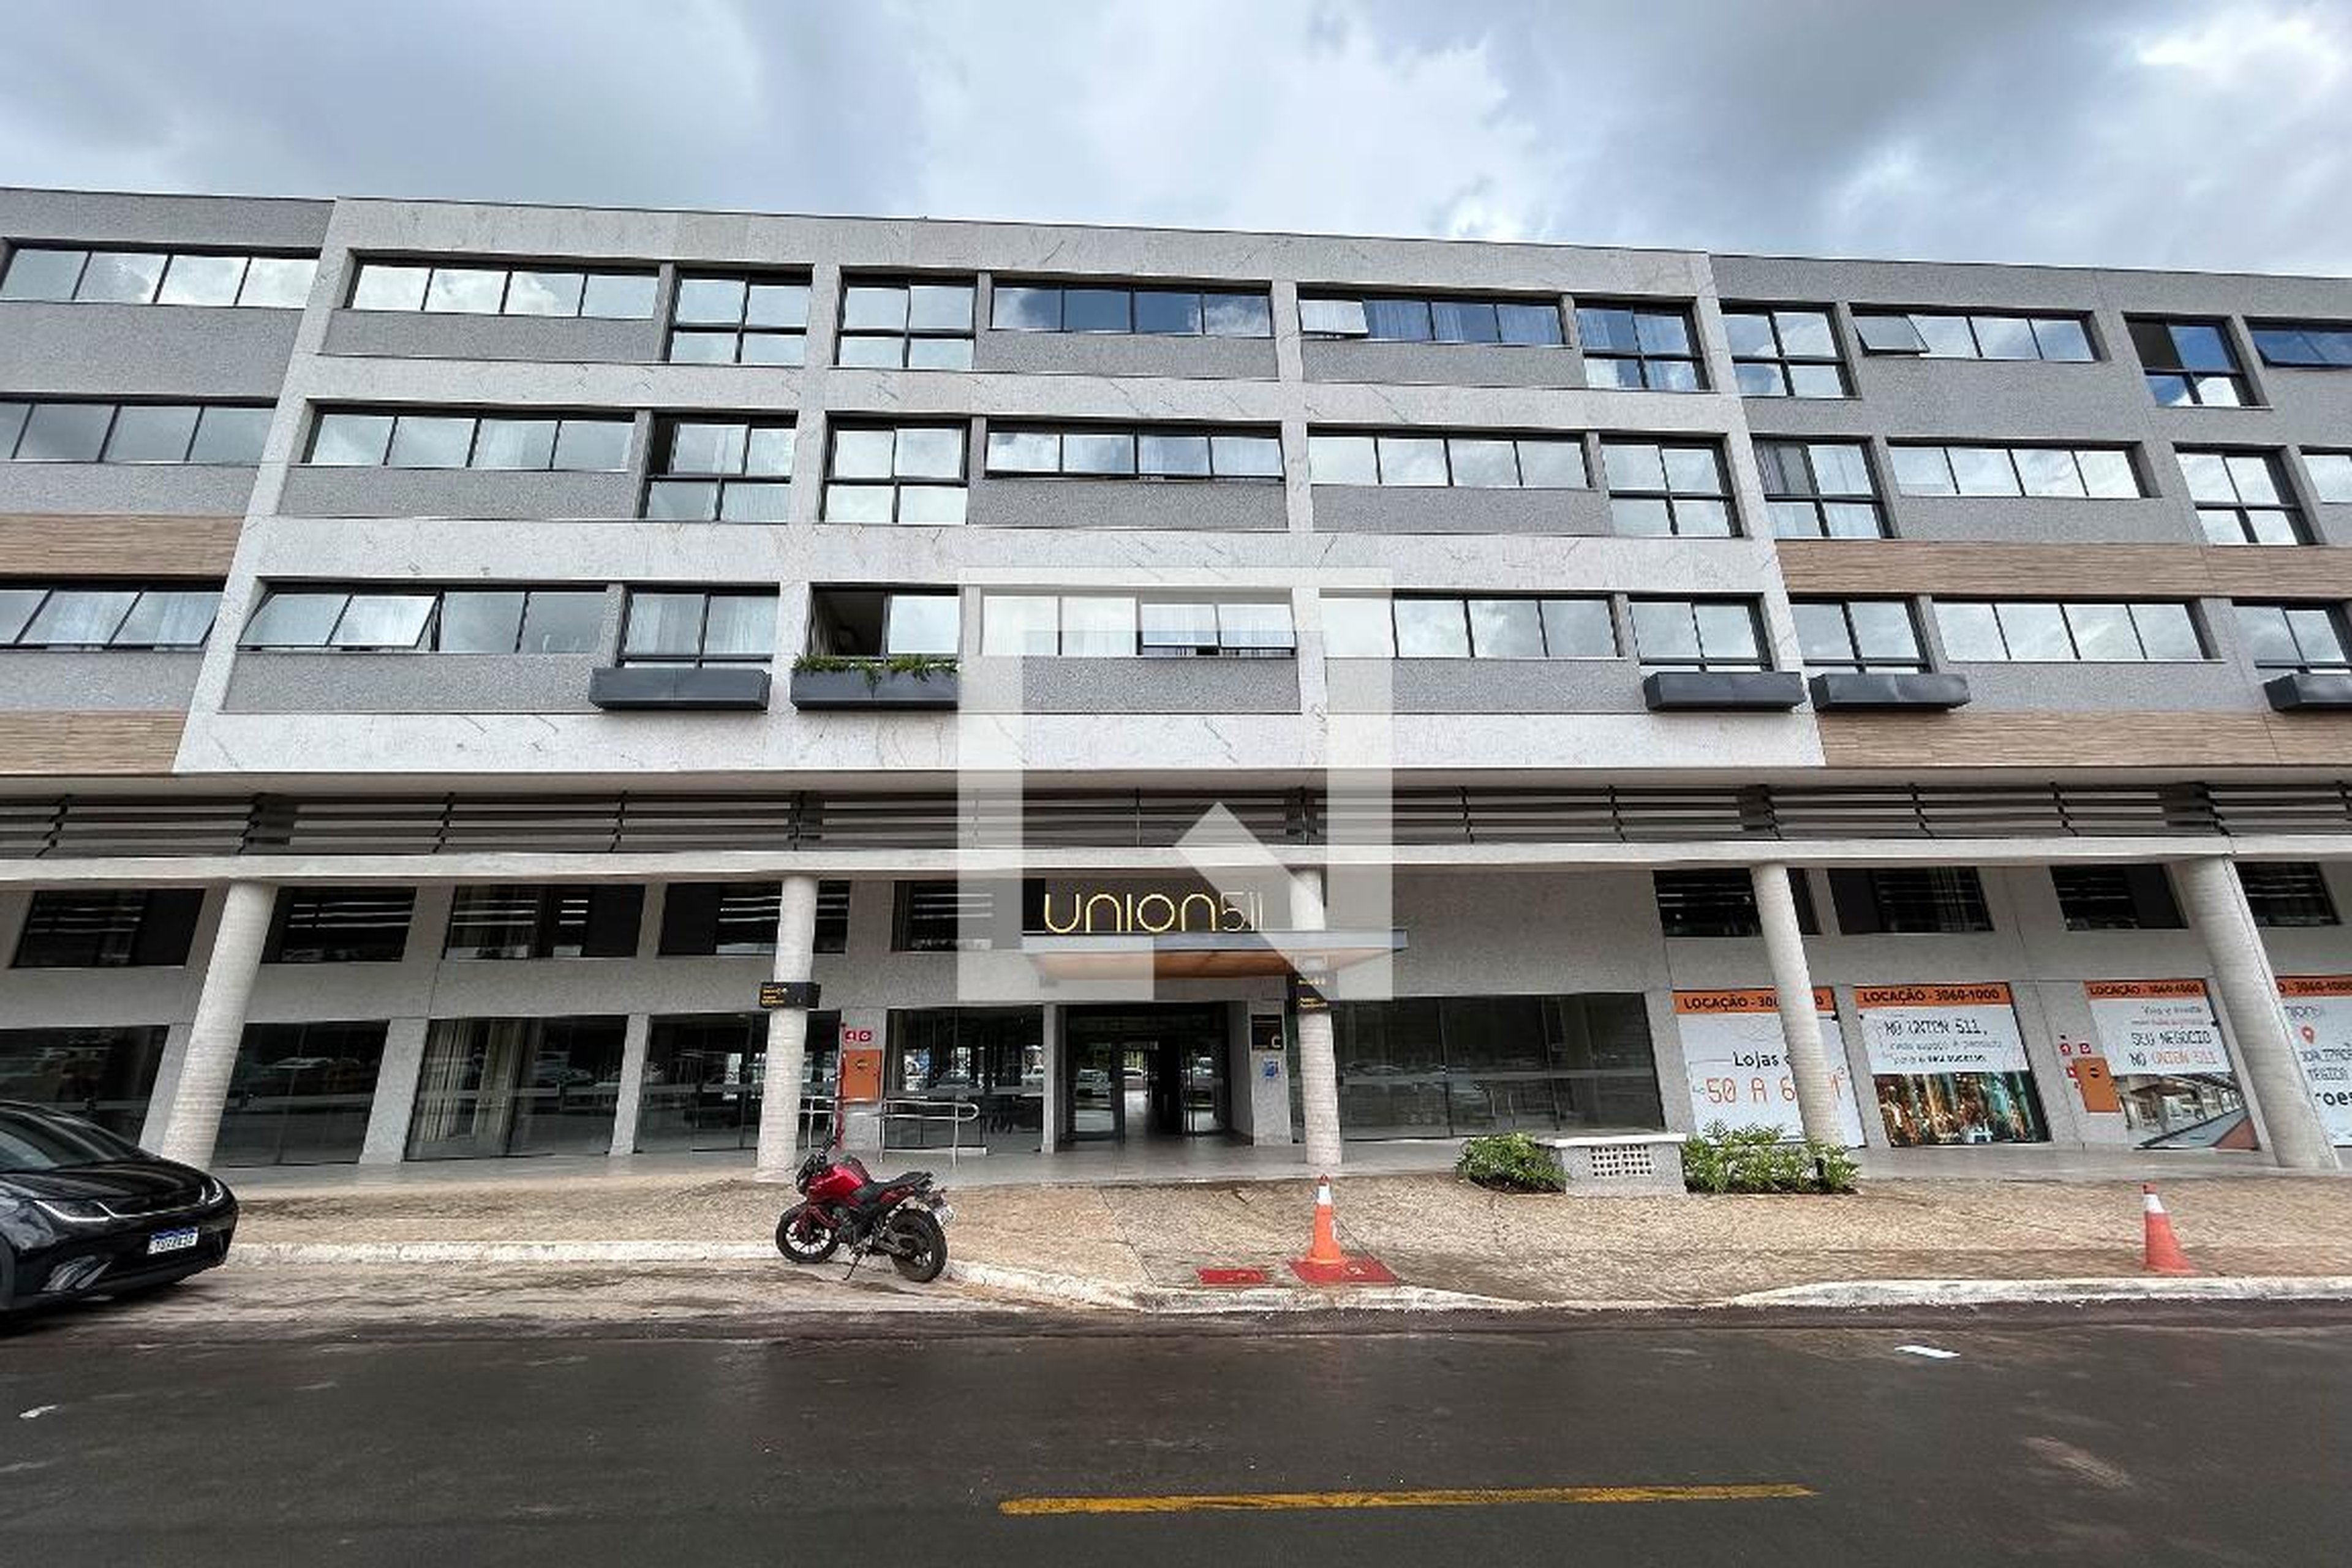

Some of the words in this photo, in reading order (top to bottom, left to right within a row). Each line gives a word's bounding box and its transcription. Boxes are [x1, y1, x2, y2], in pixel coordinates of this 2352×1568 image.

[1684, 994, 1748, 1011] LOCAÇÃO
[1863, 988, 1926, 1005] LOCAÇÃO
[1733, 1050, 1779, 1069] Lojas
